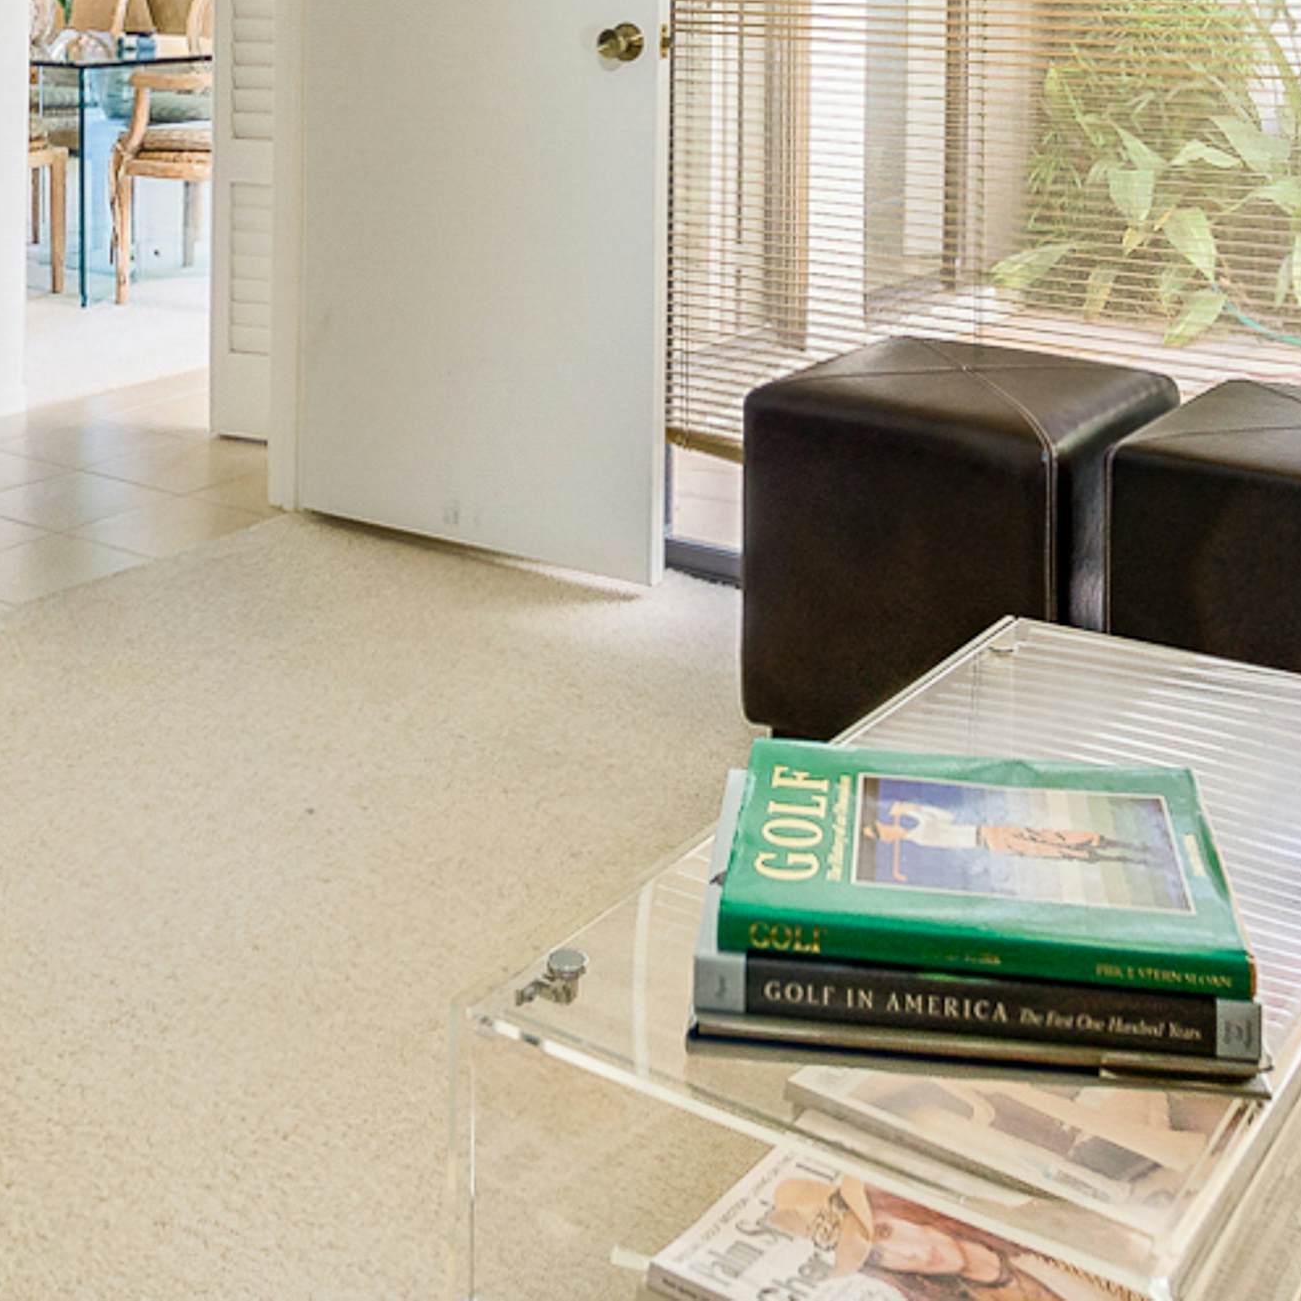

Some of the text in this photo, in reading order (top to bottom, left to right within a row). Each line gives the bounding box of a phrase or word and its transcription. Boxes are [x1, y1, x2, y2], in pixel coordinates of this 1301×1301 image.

[753, 764, 830, 882] GOLF
[750, 921, 828, 954] GOLF
[763, 980, 836, 1006] GOLF
[847, 988, 874, 1009] IN
[886, 991, 1008, 1023] AMERICA
[1046, 1010, 1073, 1027] First
[1076, 1012, 1105, 1031] One
[1107, 1015, 1163, 1038] Hundred
[1167, 1021, 1202, 1041] Years
